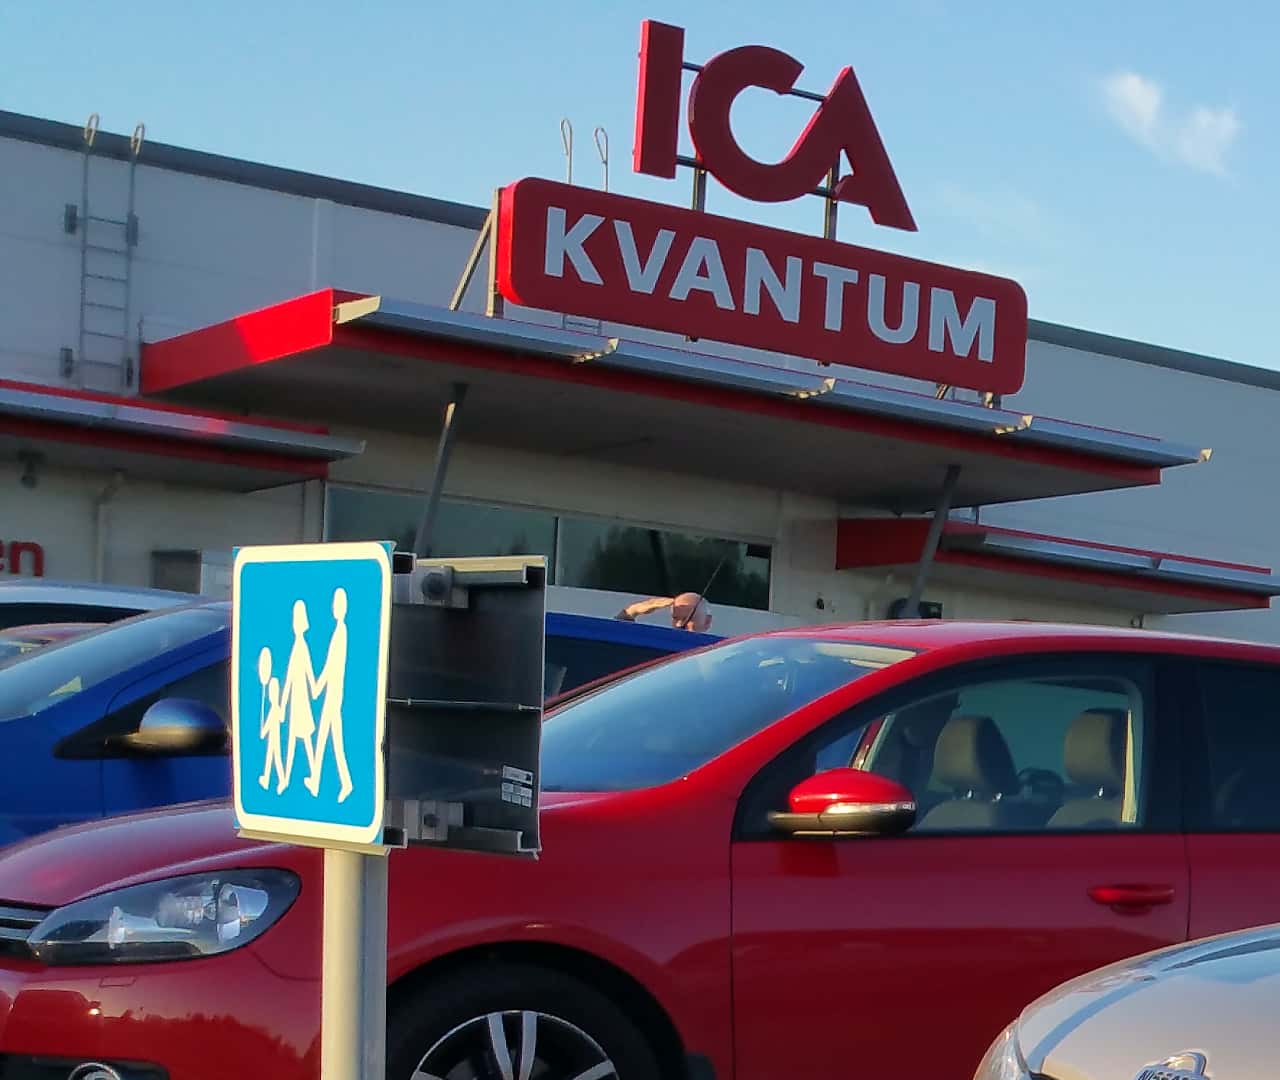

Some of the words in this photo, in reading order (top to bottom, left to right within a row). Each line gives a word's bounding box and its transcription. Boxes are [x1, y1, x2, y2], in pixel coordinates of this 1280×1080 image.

[633, 18, 919, 232] ICA
[543, 206, 997, 363] KVANTUM
[0, 540, 45, 577] n
